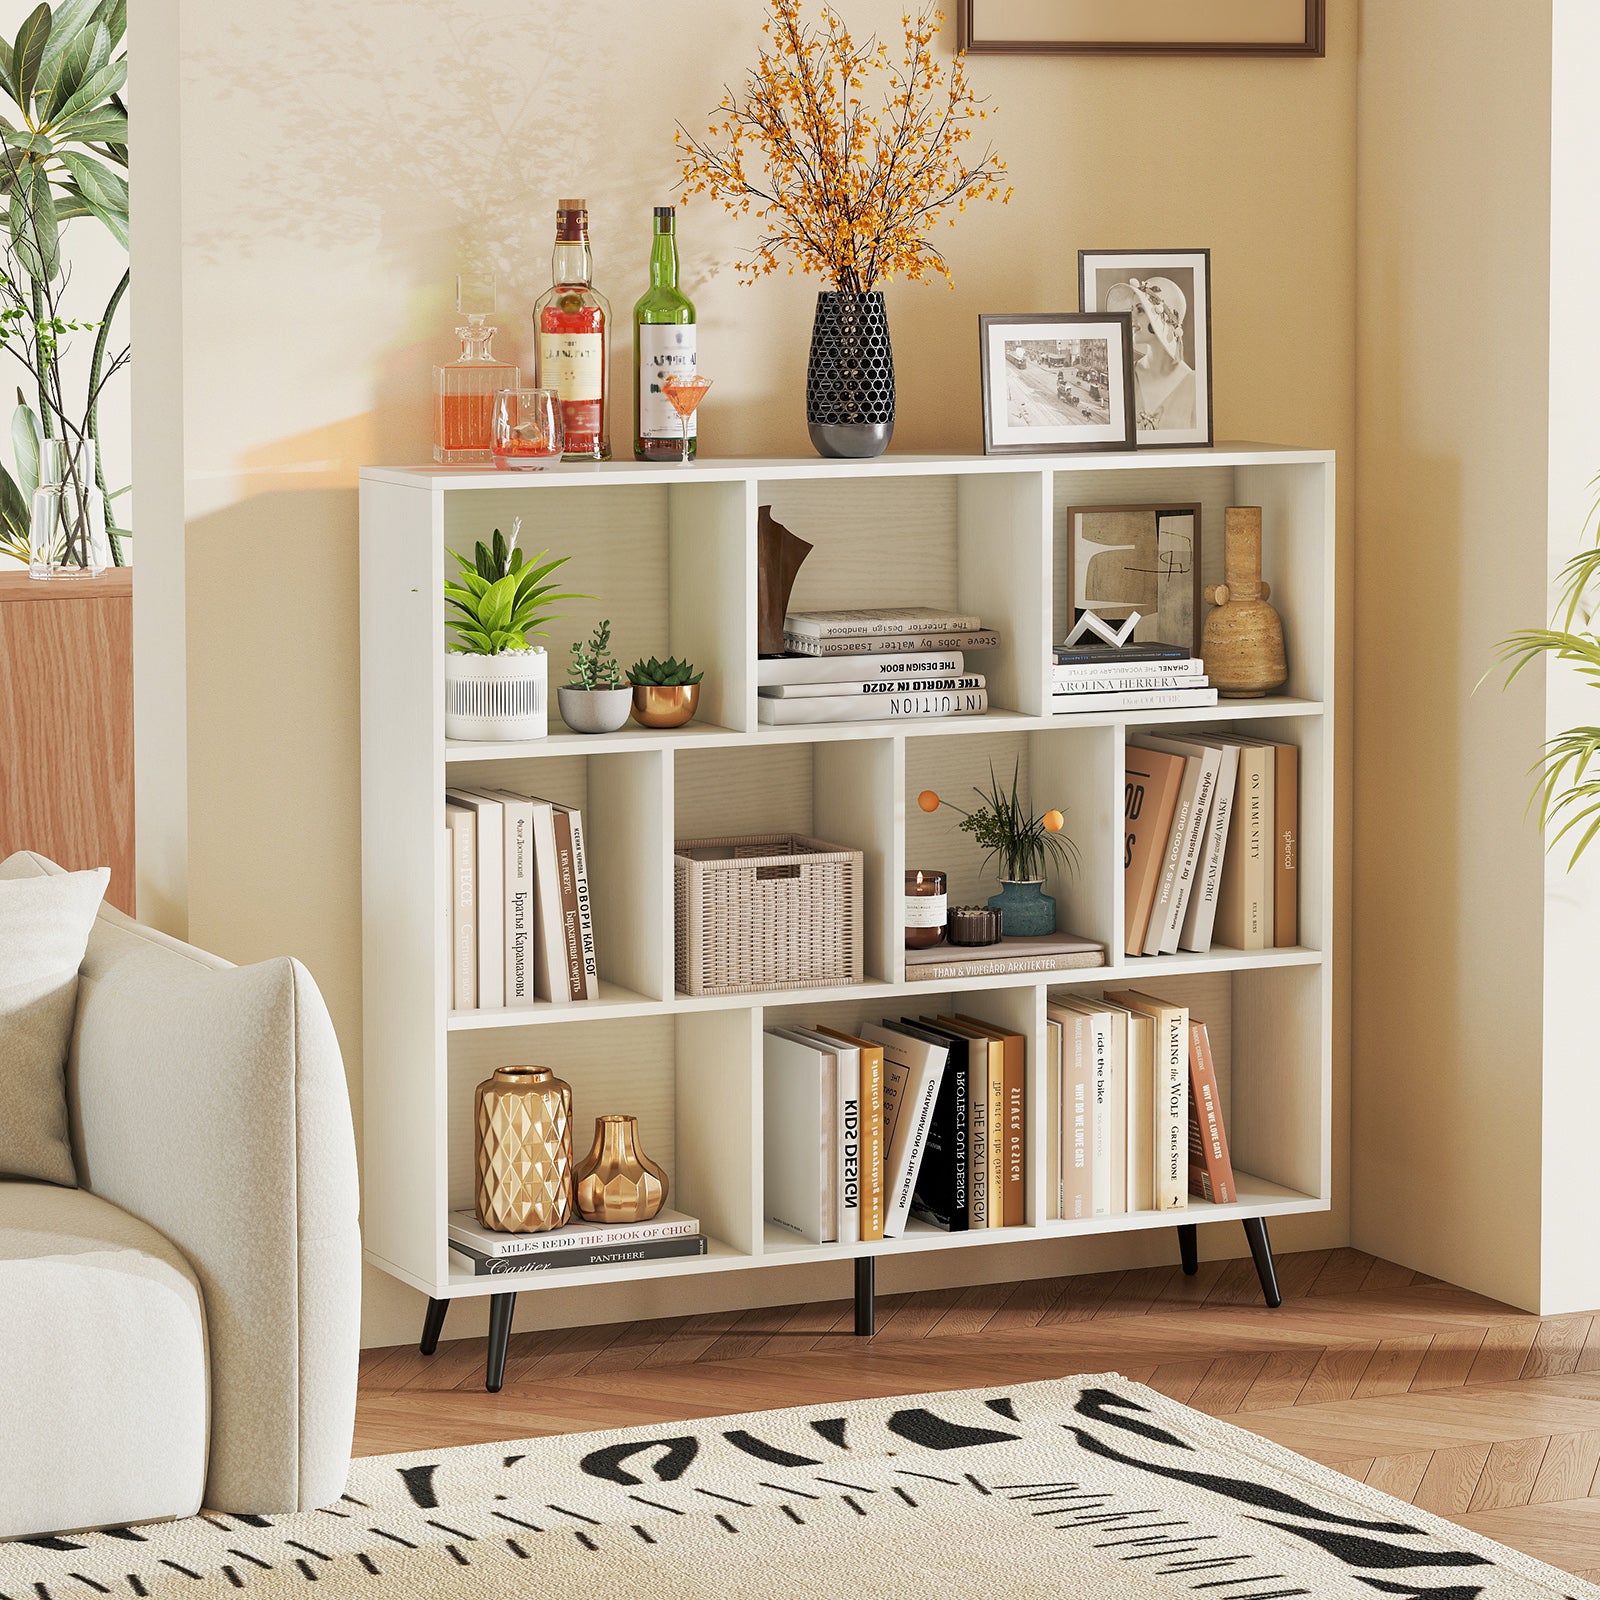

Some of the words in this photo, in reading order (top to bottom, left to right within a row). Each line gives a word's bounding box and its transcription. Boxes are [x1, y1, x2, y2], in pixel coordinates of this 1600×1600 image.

[827, 625, 869, 635] Handbook
[871, 624, 903, 633] Design
[908, 622, 948, 631] Interior
[952, 622, 968, 630] The
[824, 642, 873, 652] Isaacson
[879, 640, 915, 650] Walter
[920, 638, 933, 648] by
[938, 637, 961, 647] Jobs
[967, 637, 997, 646] Steve
[880, 664, 905, 673] BOOK
[906, 662, 938, 672] DESIGN
[938, 661, 956, 670] THE
[1158, 664, 1189, 672] CHANEL
[862, 682, 894, 694] 2020
[898, 681, 910, 692] IN
[912, 679, 956, 691] WORLD
[957, 678, 981, 689] THE
[1053, 678, 1114, 692] AROLINA
[1119, 676, 1179, 689] HERRERA
[890, 694, 982, 714] INTUITION
[1251, 773, 1260, 790] ON
[1177, 800, 1190, 830] GUIDE
[1215, 797, 1228, 832] AWAKE
[1180, 868, 1190, 881] for
[1186, 807, 1204, 858] sustainable
[1198, 771, 1212, 806] lifestyle
[1250, 795, 1260, 859] IMMUNITY
[1171, 832, 1182, 861] GOOD
[1213, 833, 1222, 853] world
[1284, 830, 1295, 870] spherical
[1211, 853, 1219, 864] the
[1165, 872, 1173, 882] IS
[1204, 864, 1217, 902] DREAM
[1160, 882, 1171, 905] THIS
[511, 891, 527, 930] Братья
[577, 878, 591, 929] ГОВОРИ
[564, 910, 579, 960] Бархатная
[583, 931, 593, 954] КАК
[511, 932, 528, 997] Карамазовы
[585, 957, 596, 976] БОГ
[933, 967, 956, 978] THAM
[957, 967, 965, 976] &
[965, 962, 1006, 976] VIDEGÅRD
[1007, 959, 1056, 973] ARKITEKTER
[569, 961, 581, 993] смерть
[1097, 1032, 1105, 1055] ride
[1170, 1015, 1182, 1065] TAMING
[1097, 1058, 1105, 1077] the
[1170, 1068, 1179, 1081] the
[1075, 1083, 1084, 1100] WHY
[1097, 1080, 1105, 1104] bike
[1170, 1082, 1182, 1118] WOLF
[1202, 1084, 1212, 1100] WHY
[1075, 1102, 1084, 1113] DO
[1205, 1101, 1214, 1111] DO
[1075, 1115, 1084, 1127] WE
[1207, 1112, 1217, 1123] WE
[1075, 1128, 1084, 1147] LOVE
[1170, 1126, 1180, 1151] GREG
[1209, 1124, 1219, 1141] LOVE
[1075, 1148, 1084, 1168] CATS
[1212, 1142, 1223, 1159] CATS
[1170, 1152, 1180, 1181] STONE
[500, 1240, 539, 1254] MILES
[542, 1237, 576, 1249] REDD
[578, 1233, 603, 1245] THE
[606, 1231, 640, 1242] BOOK
[642, 1228, 659, 1238] OF
[661, 1224, 692, 1235] CHIC
[485, 1256, 551, 1275] Cartier
[590, 1251, 645, 1263] PANTHERE
